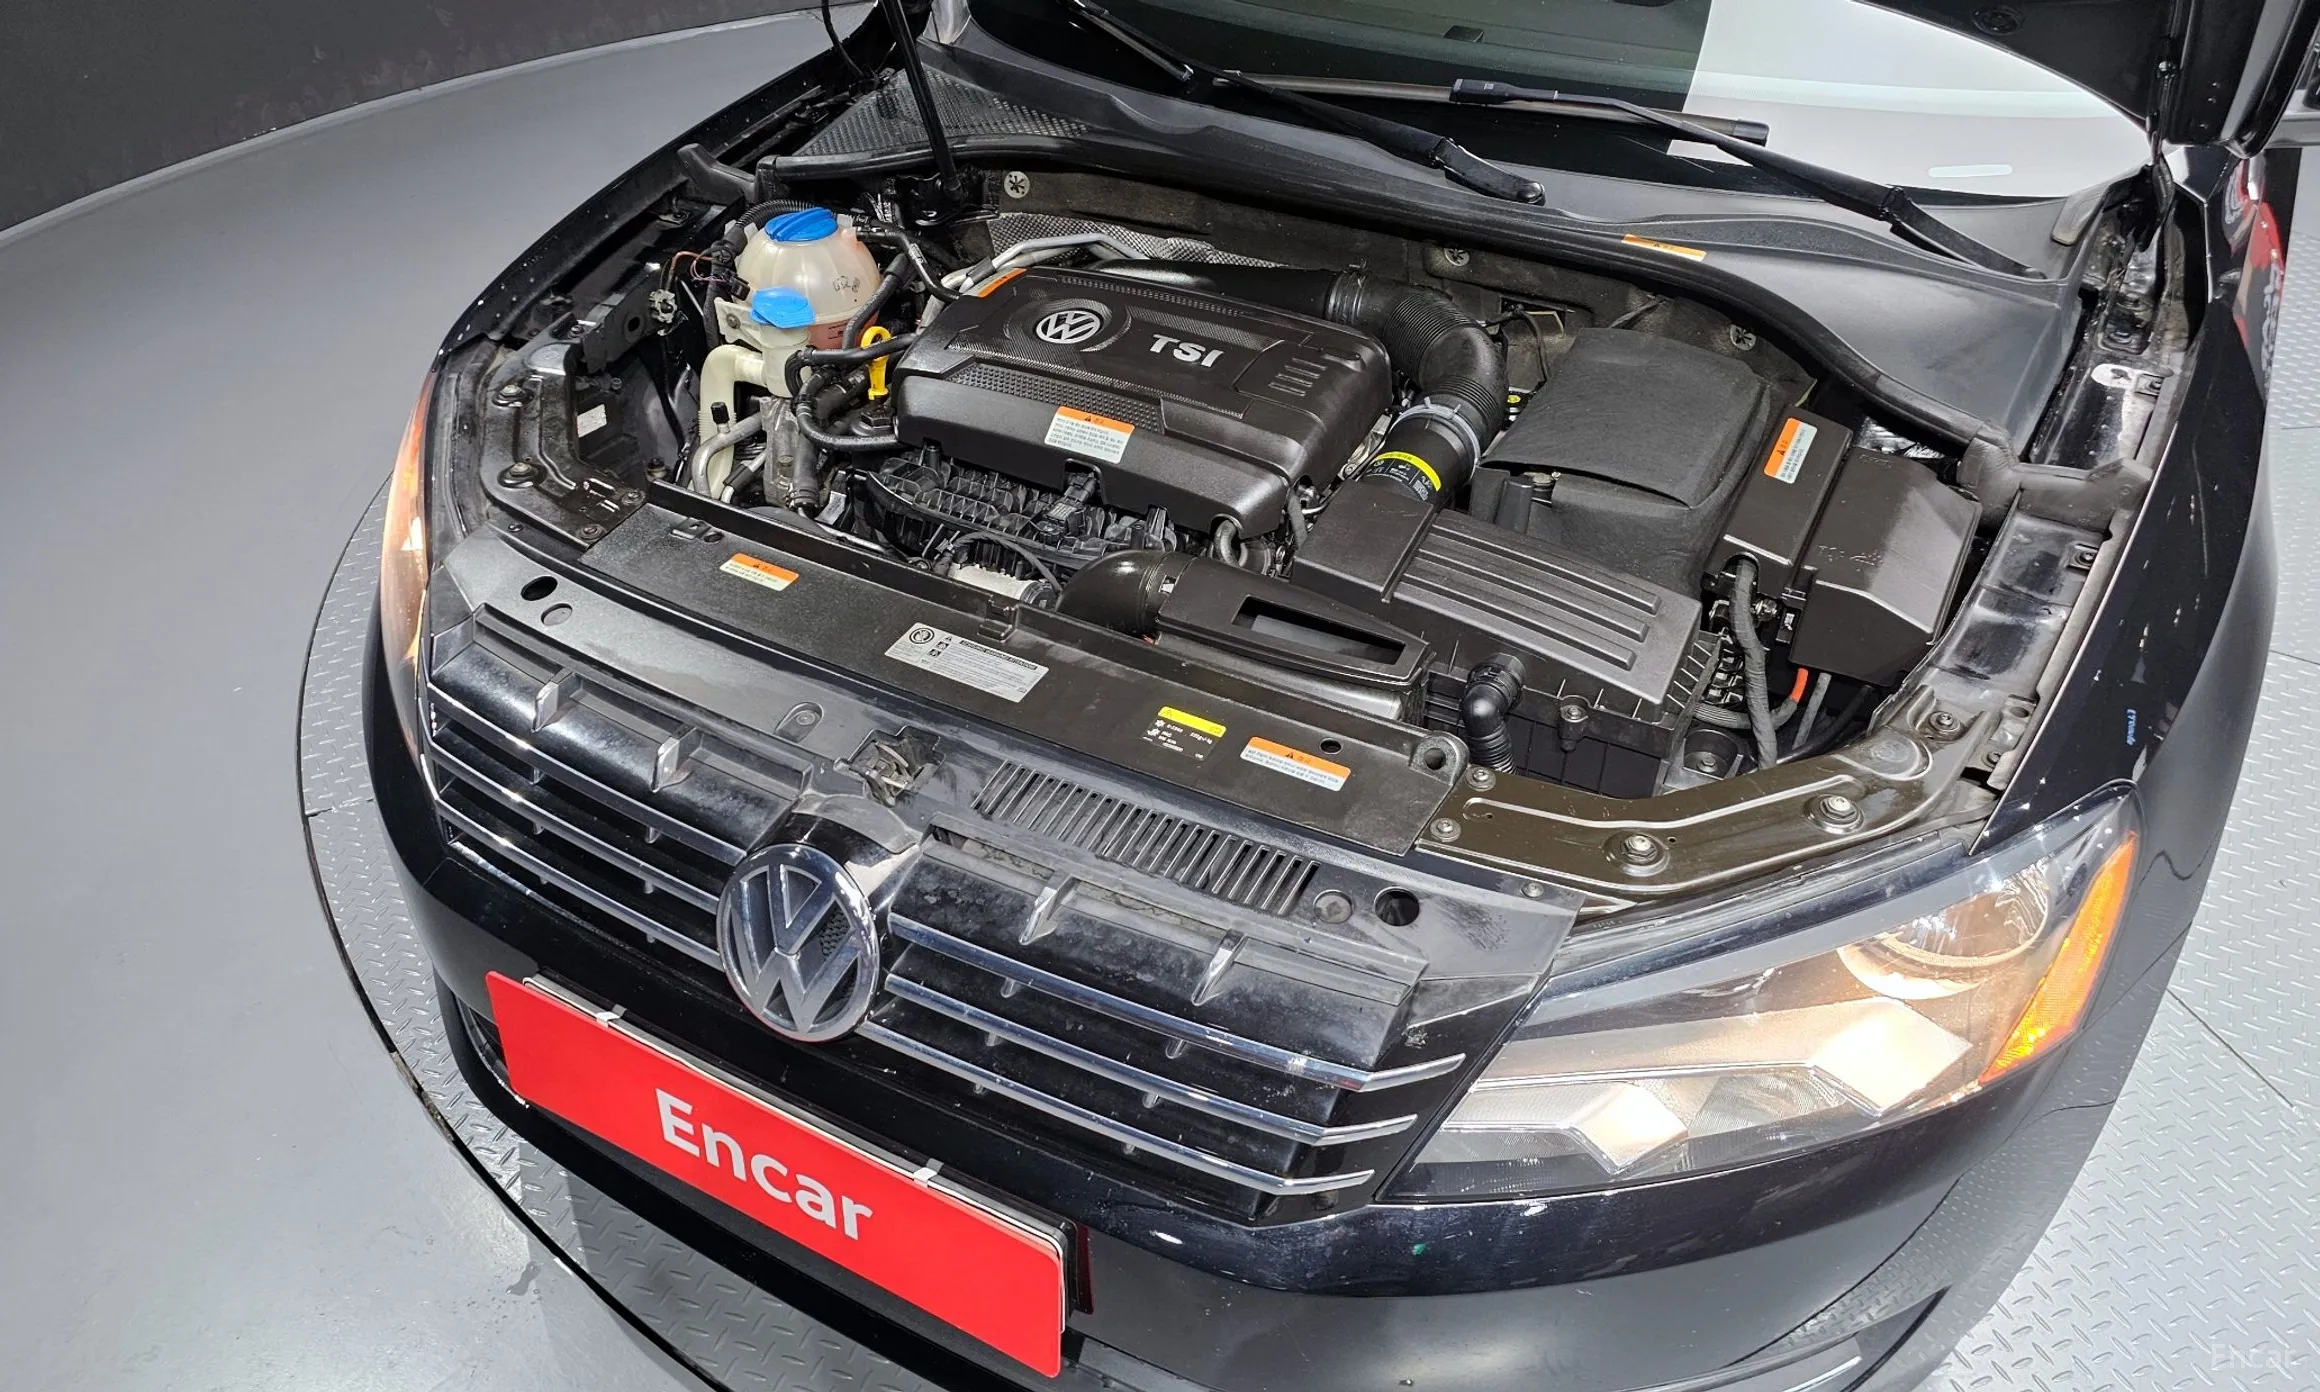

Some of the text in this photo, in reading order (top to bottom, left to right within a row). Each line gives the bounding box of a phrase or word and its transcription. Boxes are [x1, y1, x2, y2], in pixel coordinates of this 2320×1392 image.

[1150, 334, 1224, 368] TSI
[716, 843, 880, 1043] VW
[655, 1088, 873, 1240] Encar
